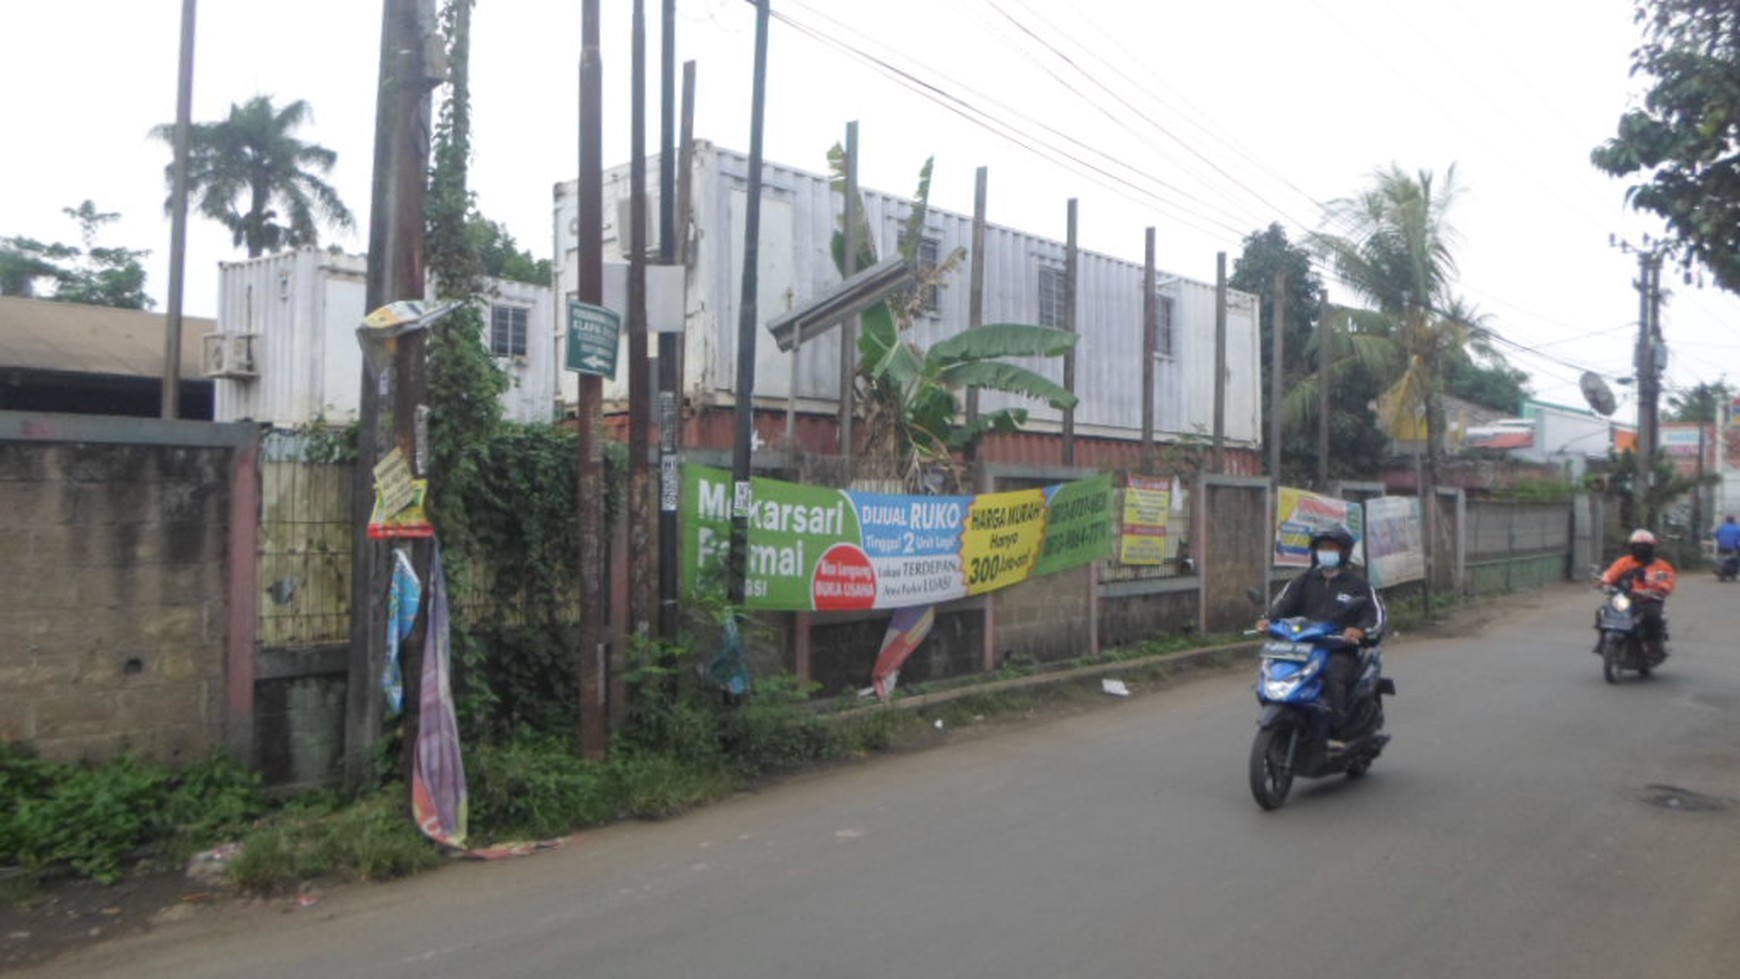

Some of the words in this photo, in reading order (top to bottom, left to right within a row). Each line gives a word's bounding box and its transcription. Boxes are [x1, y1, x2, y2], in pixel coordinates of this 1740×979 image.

[698, 479, 843, 536] Mkarsari
[862, 505, 907, 526] DIJUAL
[910, 502, 960, 530] RUKO
[970, 507, 1006, 531] HARGA
[1007, 502, 1042, 526] MURAH
[903, 531, 915, 554] 2
[990, 531, 1019, 550] Hanya
[969, 555, 999, 585] 300
